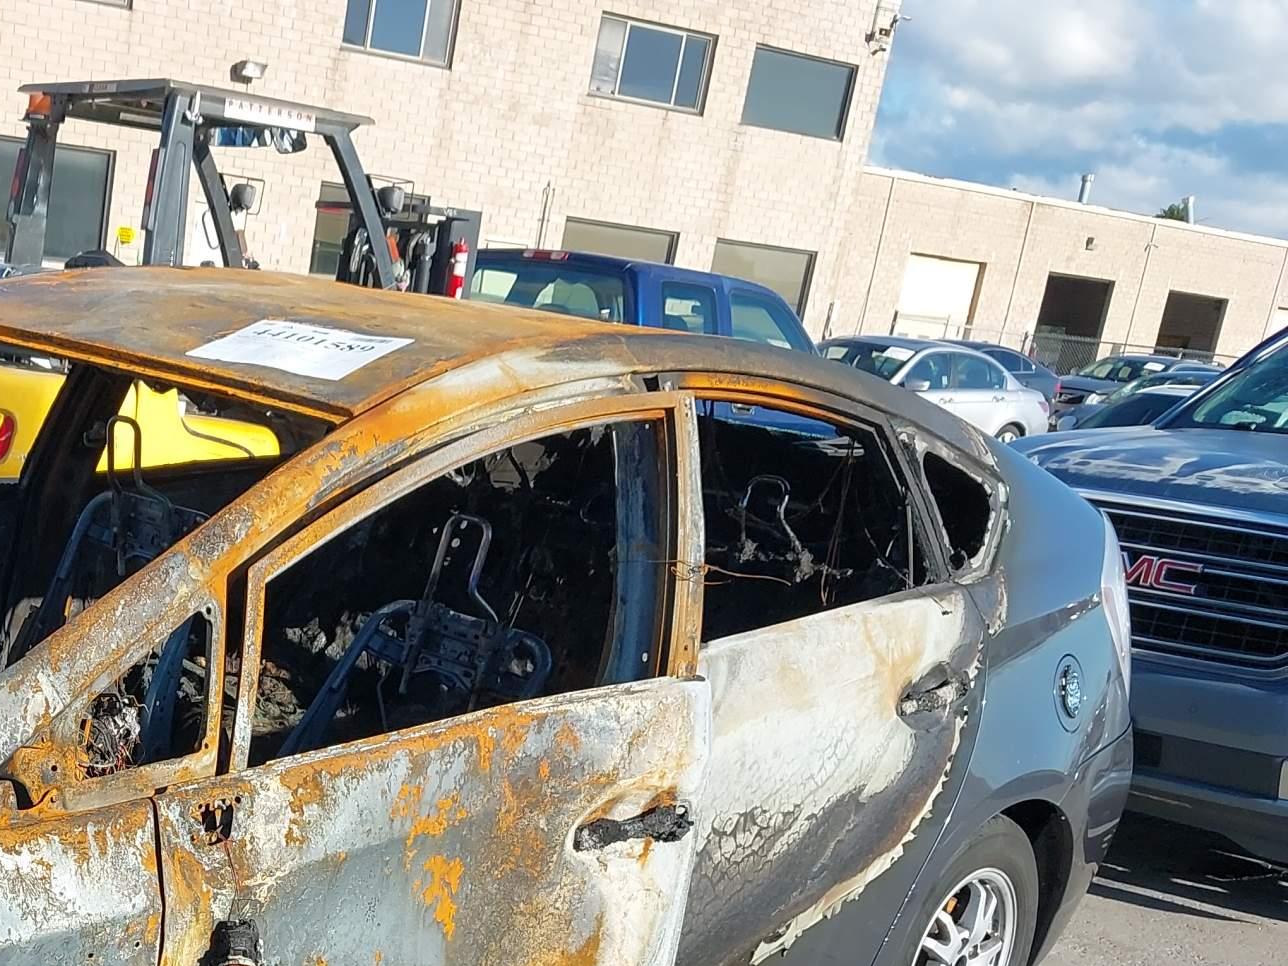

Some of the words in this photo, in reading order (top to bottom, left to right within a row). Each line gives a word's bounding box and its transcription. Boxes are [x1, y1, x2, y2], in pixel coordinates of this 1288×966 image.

[227, 100, 313, 122] PATTERSON
[253, 329, 375, 352] 44101589
[1120, 551, 1203, 594] MC
